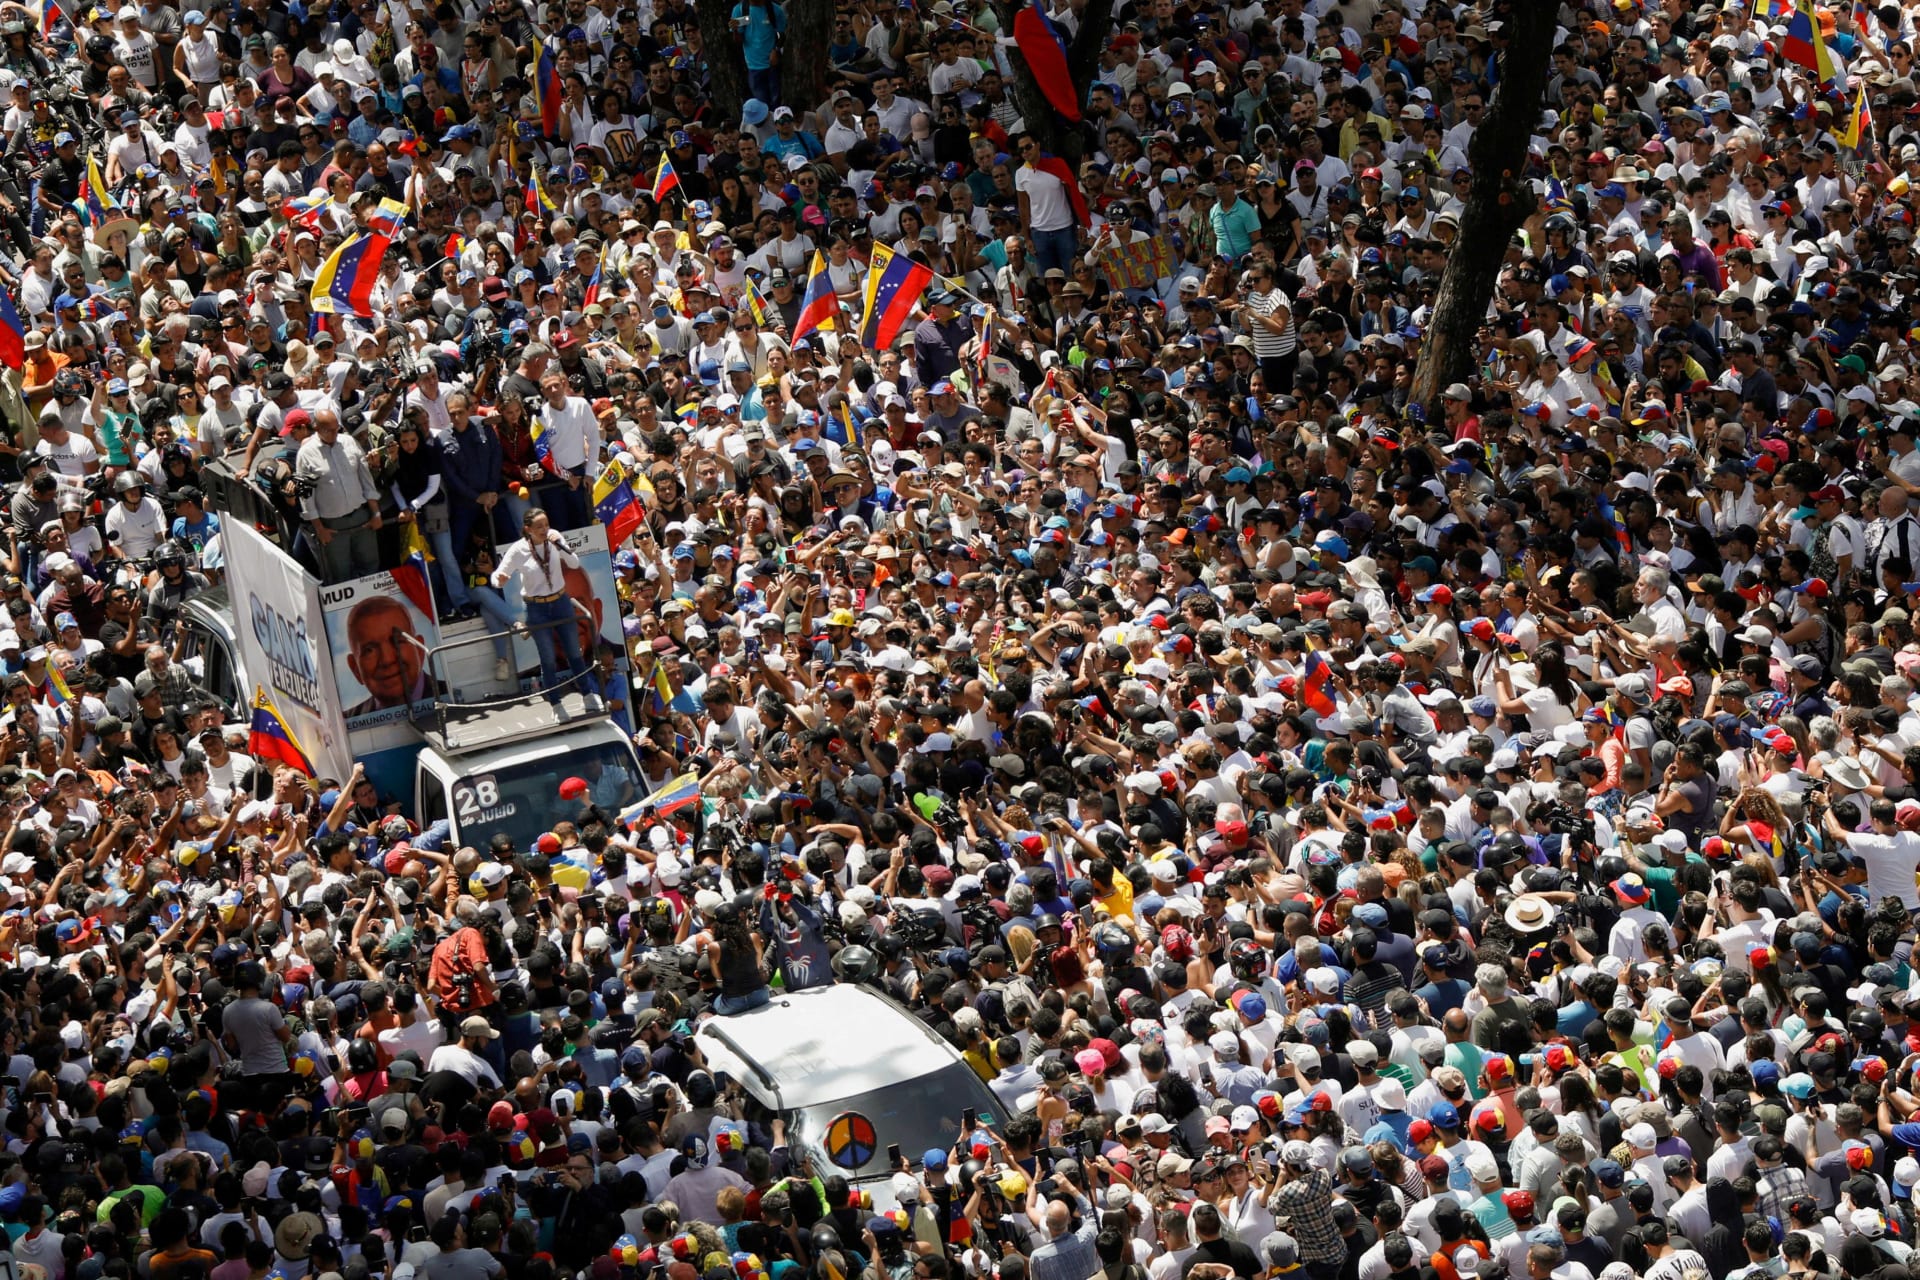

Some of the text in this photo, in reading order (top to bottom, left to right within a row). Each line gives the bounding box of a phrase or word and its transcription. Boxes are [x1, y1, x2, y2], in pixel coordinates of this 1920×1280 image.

[321, 587, 354, 605] MUD
[394, 701, 436, 718] GOZÁL
[455, 781, 498, 816] 28
[477, 803, 516, 824] JULIO
